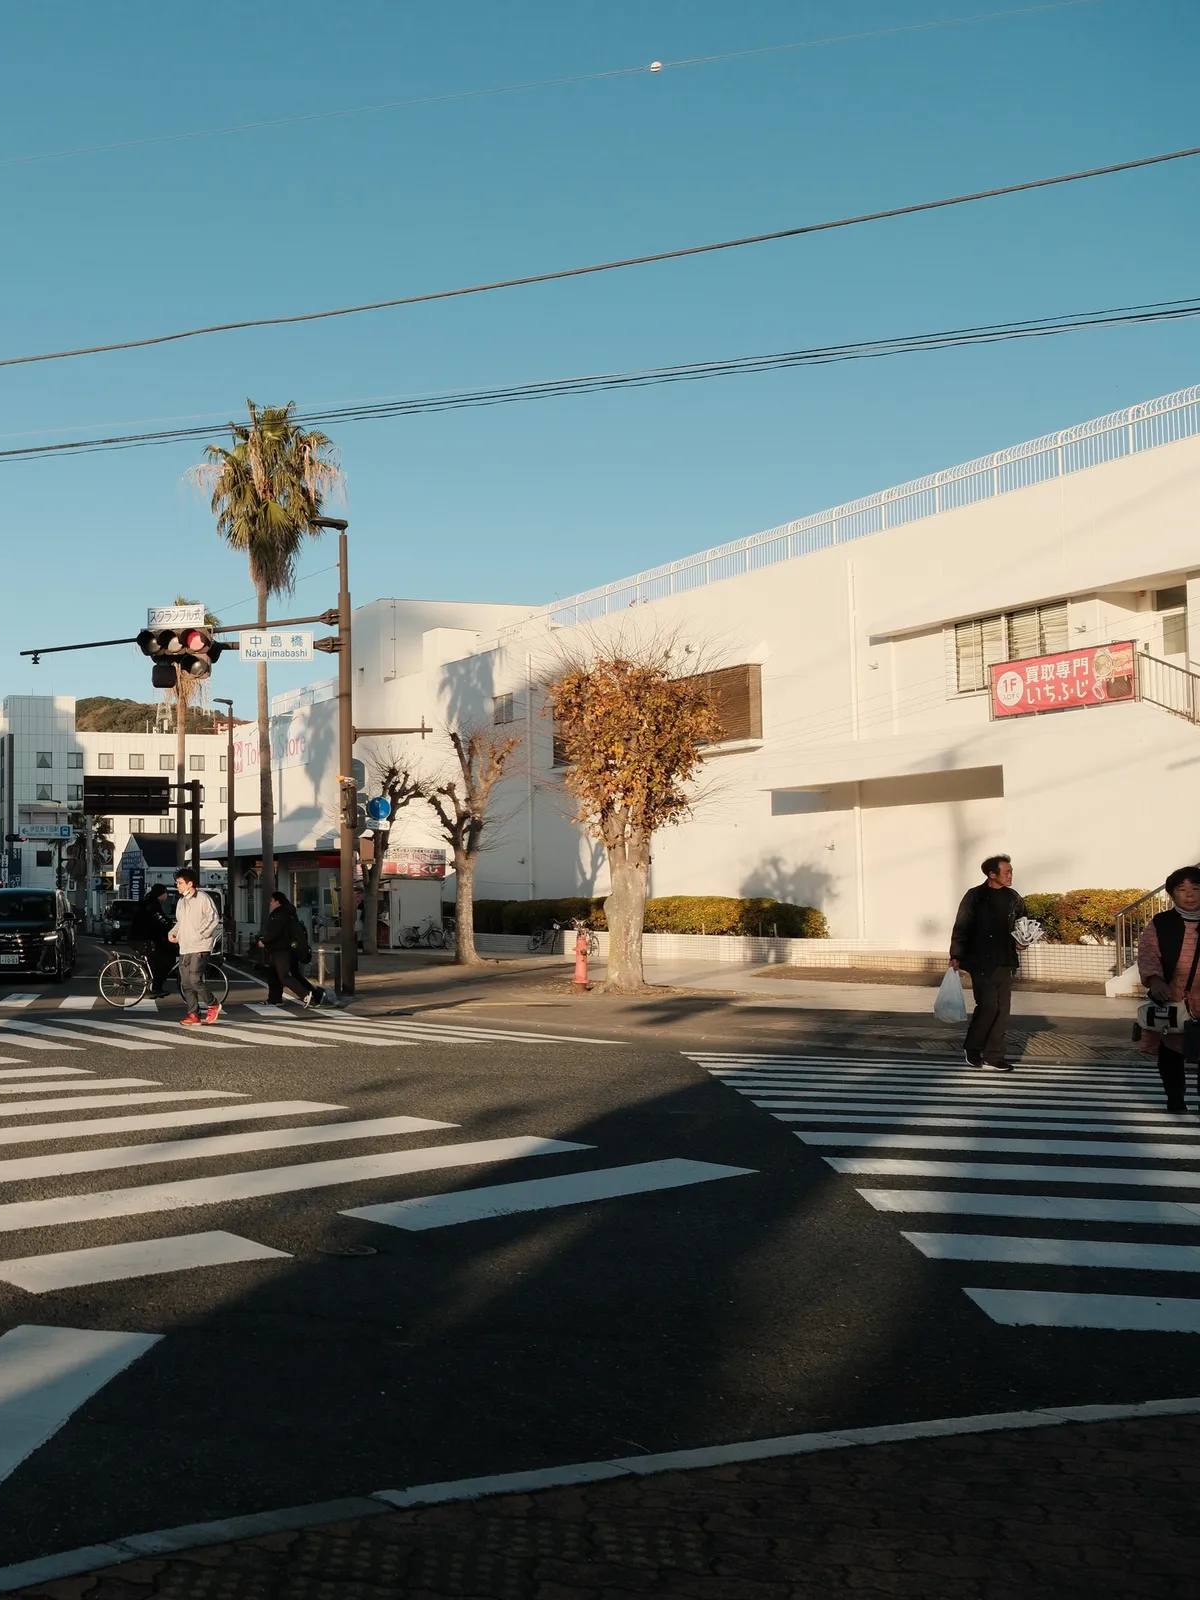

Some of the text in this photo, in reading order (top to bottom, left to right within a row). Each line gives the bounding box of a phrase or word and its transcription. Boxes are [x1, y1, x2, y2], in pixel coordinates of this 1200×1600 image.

[150, 609, 201, 623] スクランブル式
[249, 635, 304, 648] 中島橋
[245, 648, 307, 658] Nakajimabashi
[1025, 657, 1089, 685] 買取専門
[1002, 677, 1017, 692] 1F
[1026, 679, 1089, 705] いちふじ
[278, 734, 306, 758] Store
[409, 864, 438, 877] 宝くじ
